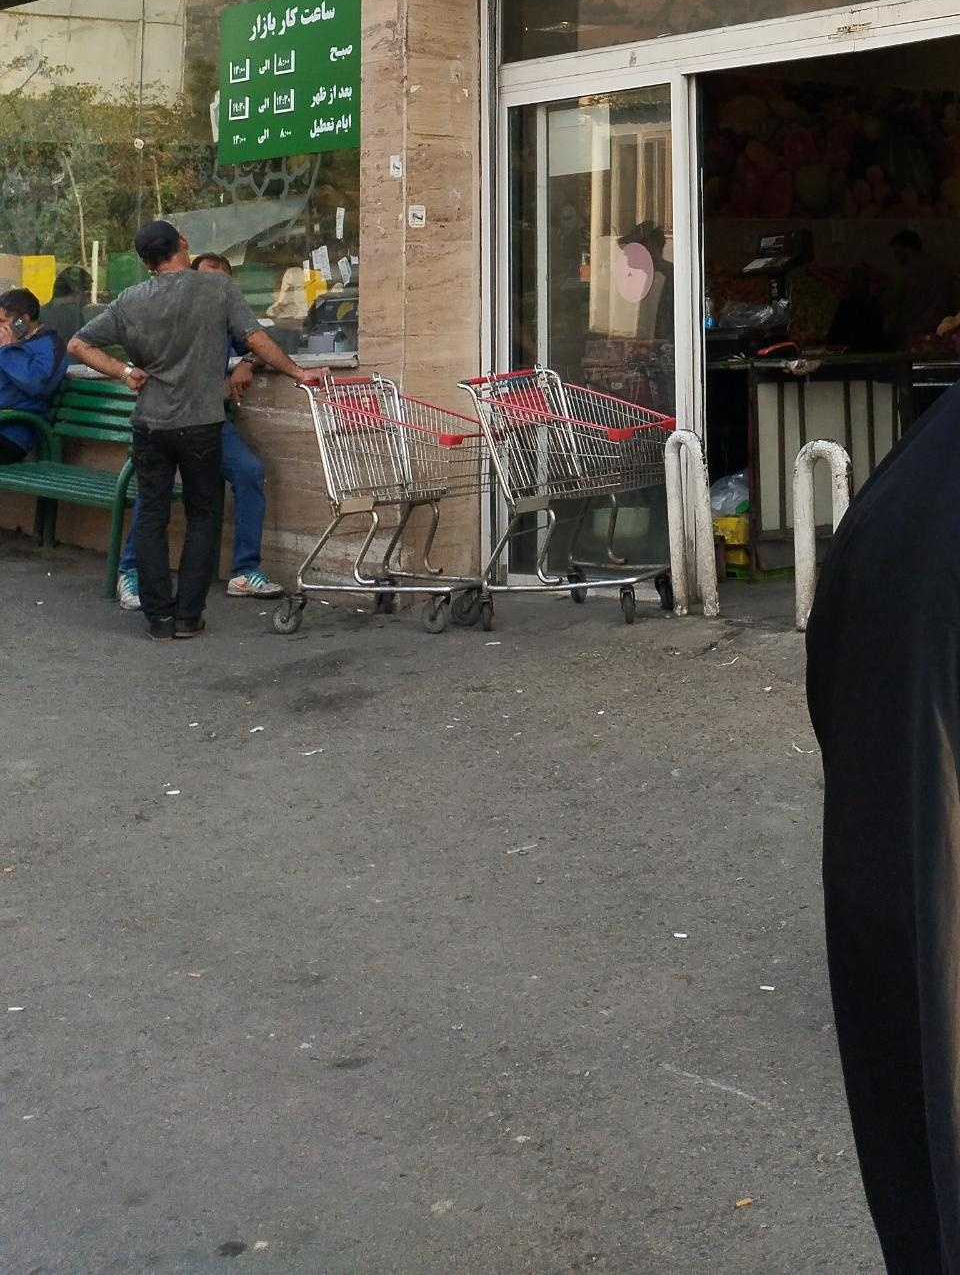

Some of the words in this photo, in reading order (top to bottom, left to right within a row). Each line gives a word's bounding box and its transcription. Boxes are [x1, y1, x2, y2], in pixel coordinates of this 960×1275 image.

[278, 6, 298, 35] کار
[300, 0, 336, 25] ساعت
[249, 11, 276, 41] بازار
[329, 44, 353, 61] صبح
[259, 59, 270, 75] الی
[310, 86, 326, 107] ظهر
[328, 85, 337, 104] از
[338, 86, 353, 101] بعد
[258, 97, 270, 113] الی
[309, 117, 335, 138] تعطیل
[335, 114, 352, 135] ایام
[257, 128, 270, 144] الی
